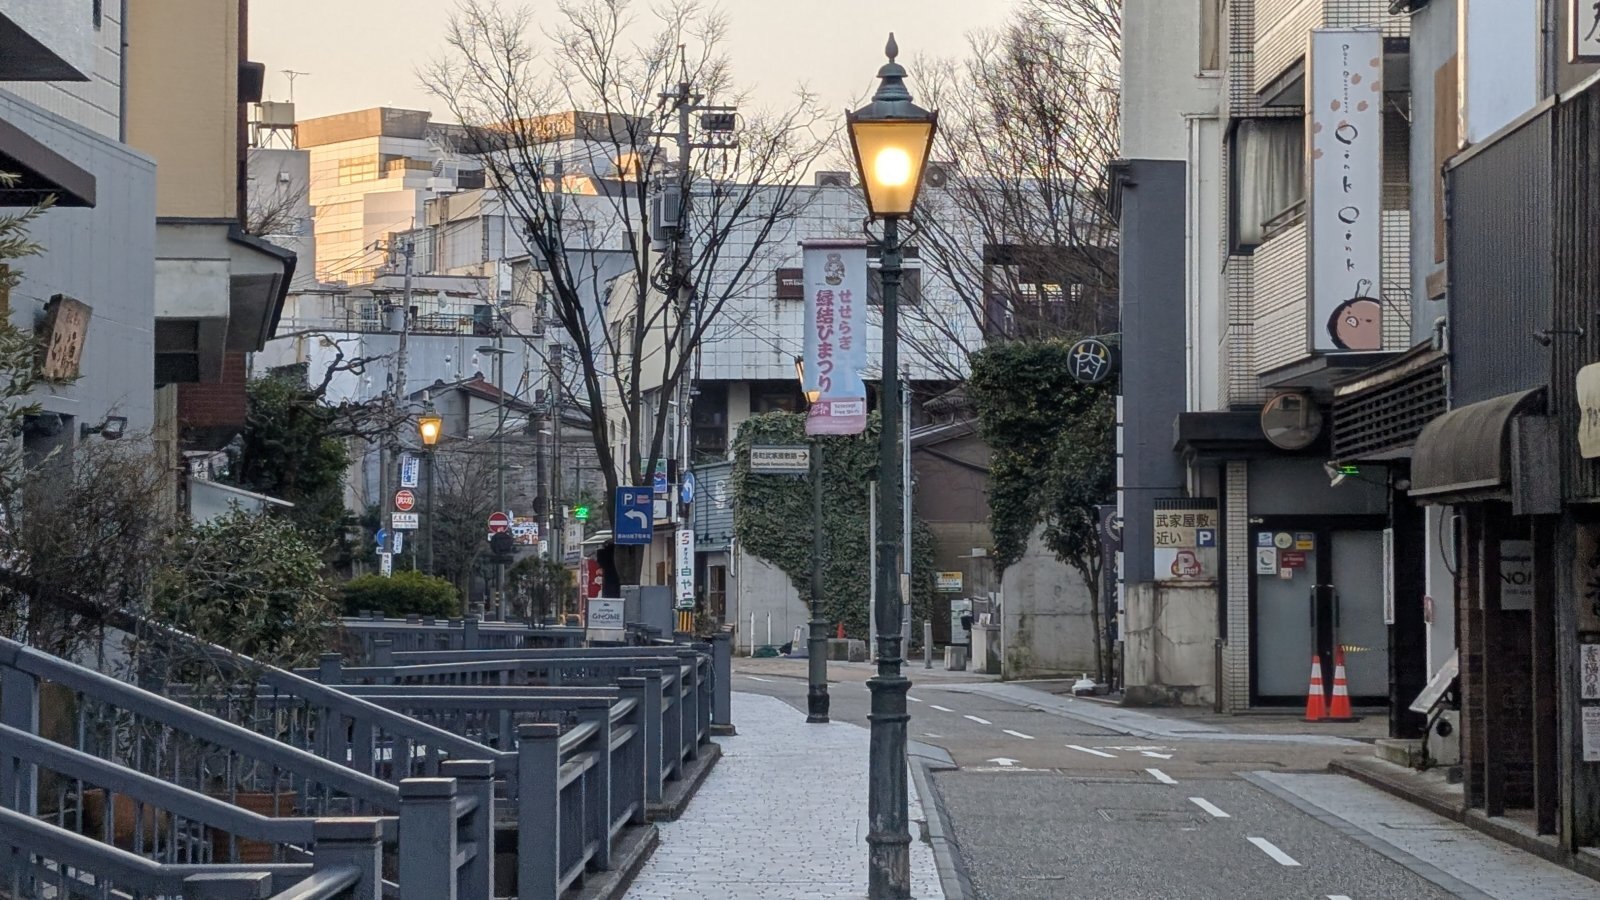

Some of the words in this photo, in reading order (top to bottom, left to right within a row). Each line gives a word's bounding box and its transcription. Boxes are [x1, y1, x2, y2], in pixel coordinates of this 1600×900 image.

[1335, 124, 1358, 193] Oink
[1338, 206, 1360, 271] Oink
[816, 289, 834, 393] 縁結びまつり
[838, 289, 852, 351] せせらぎ
[624, 493, 633, 505] P
[1156, 531, 1182, 545] 近い
[1199, 531, 1212, 545] P
